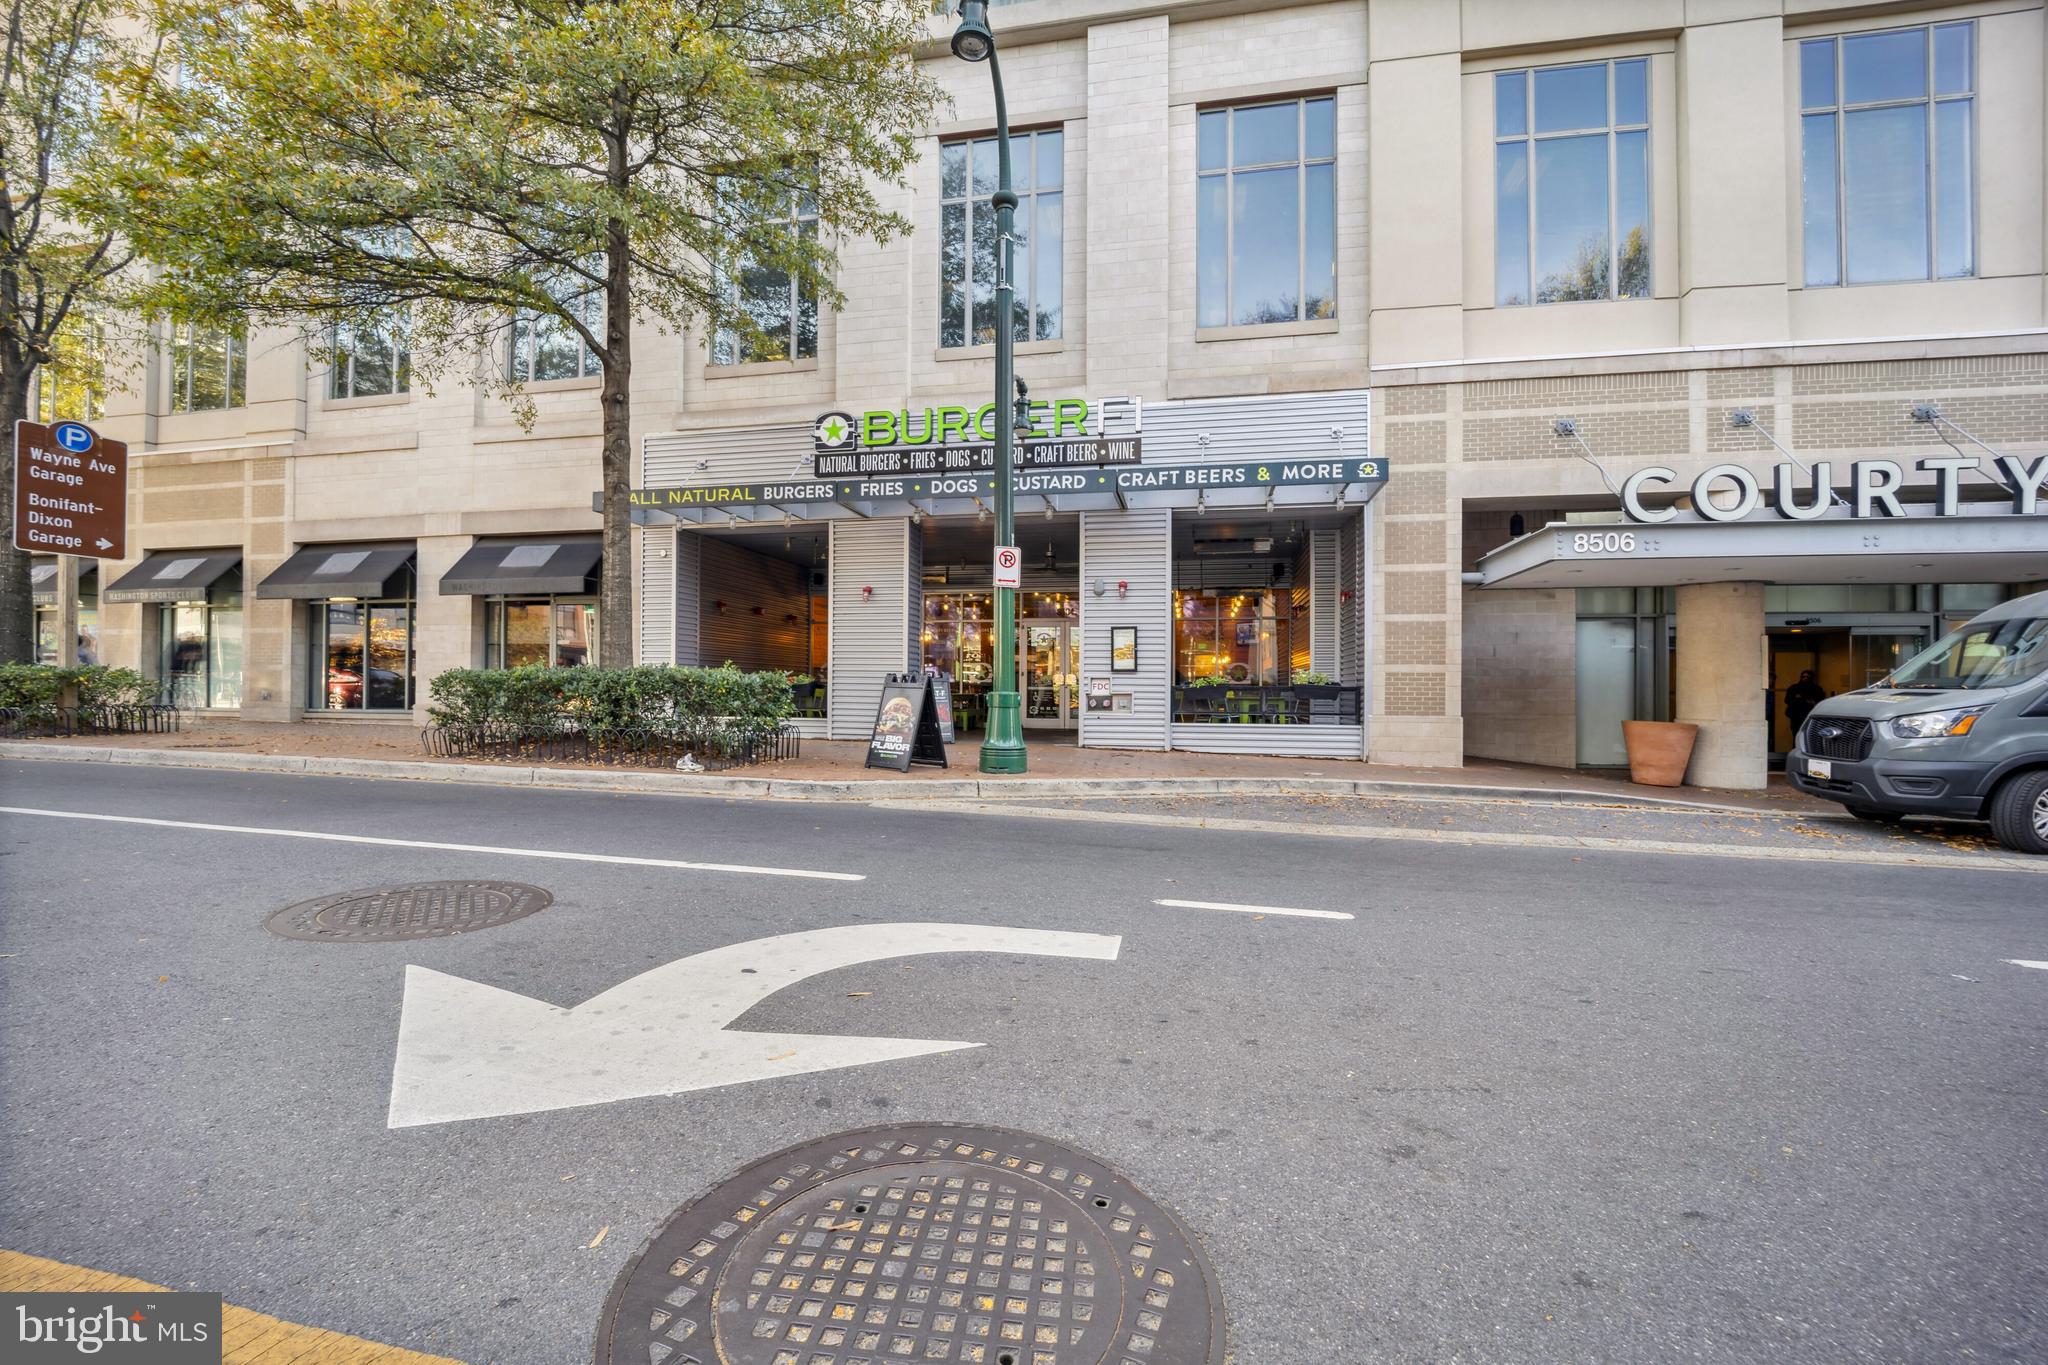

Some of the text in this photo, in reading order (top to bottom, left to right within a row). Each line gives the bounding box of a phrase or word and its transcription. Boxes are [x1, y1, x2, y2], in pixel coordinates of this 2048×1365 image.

[30, 447, 117, 474] Wayne Ave
[819, 455, 858, 474] NATURAL
[860, 453, 901, 472] BURGERS
[910, 451, 936, 469] FRIES
[945, 449, 971, 467] DOGS
[1034, 445, 1065, 463] CRAFT
[1066, 443, 1098, 461] BEERS
[1108, 441, 1136, 459] WINE
[29, 465, 84, 486] Garage
[629, 491, 662, 505] ALL
[668, 487, 756, 504] NATURAL
[763, 484, 834, 500] BURGERS
[860, 481, 904, 496] FRIES
[931, 478, 978, 494] DOGS
[1118, 469, 1180, 487] CRAFT
[1185, 467, 1246, 484] BEERS
[1256, 466, 1271, 481] &
[1282, 463, 1343, 480] MORE
[28, 511, 73, 528] Dixon
[28, 529, 83, 548] Garage
[1573, 532, 1636, 554] 8506
[1092, 682, 1109, 690] FDC
[871, 741, 910, 751] FLAVOR
[885, 734, 903, 743] BIG
